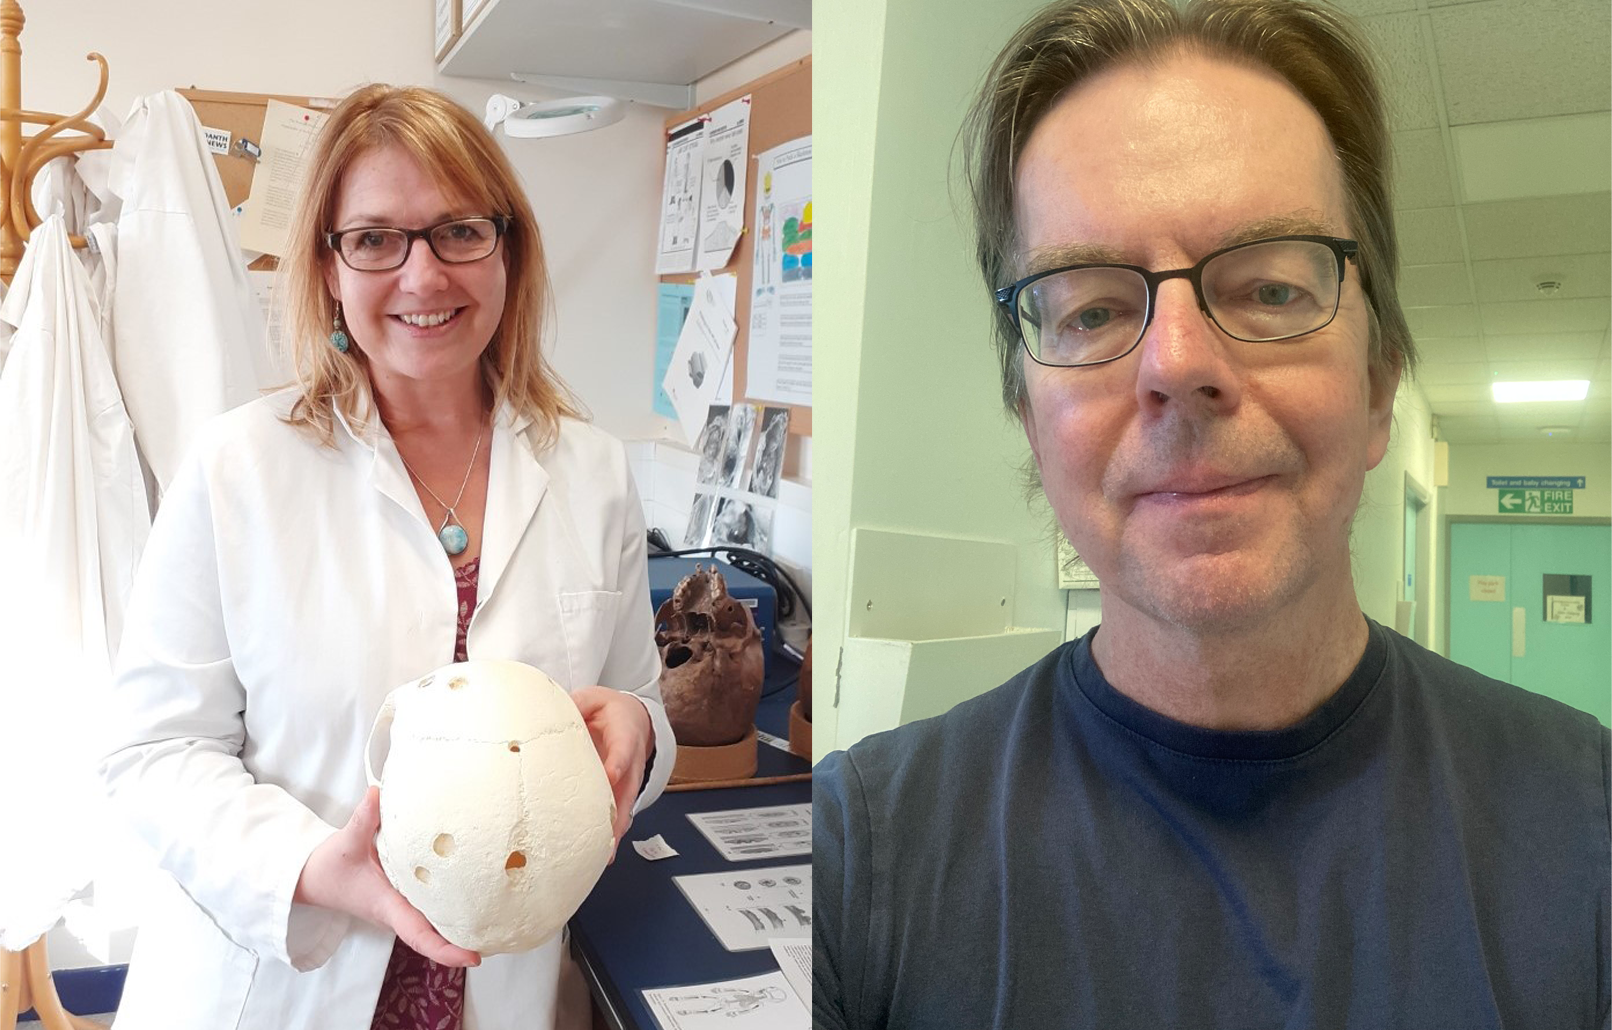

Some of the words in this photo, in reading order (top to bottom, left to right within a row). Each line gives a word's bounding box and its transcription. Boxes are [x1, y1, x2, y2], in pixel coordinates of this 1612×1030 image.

[1523, 479, 1539, 487] baby
[1541, 479, 1571, 487] changing
[1544, 490, 1572, 501] FIRE
[1544, 502, 1572, 512] EXIT
